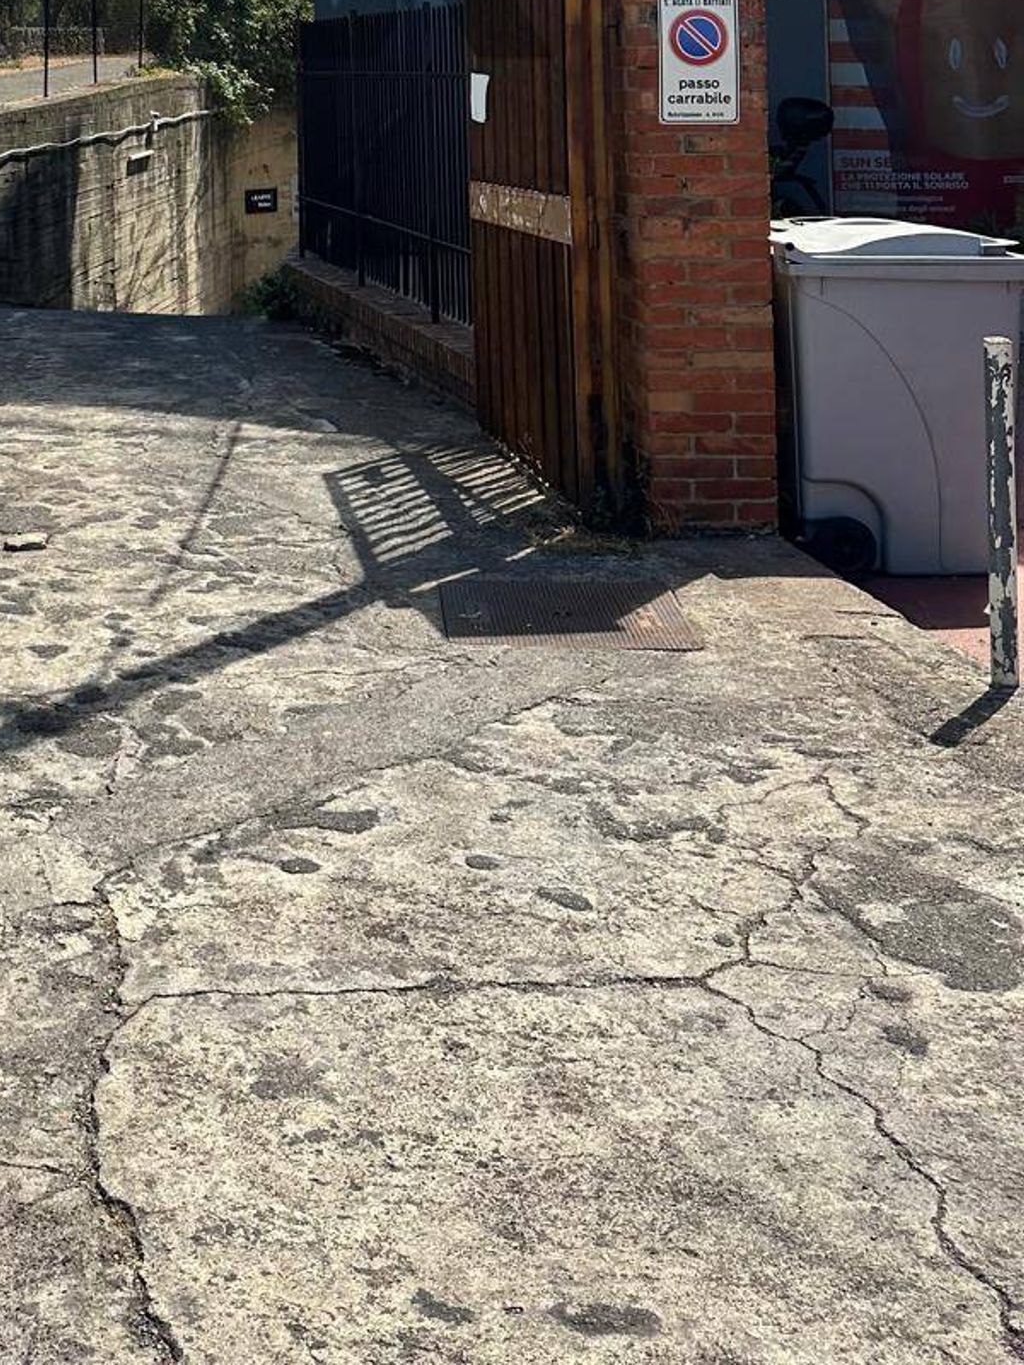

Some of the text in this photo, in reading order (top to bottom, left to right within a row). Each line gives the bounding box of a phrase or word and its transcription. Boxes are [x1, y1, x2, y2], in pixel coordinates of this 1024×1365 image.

[679, 80, 720, 90] passo
[668, 93, 731, 104] carrabile
[924, 180, 969, 190] SORRISO
